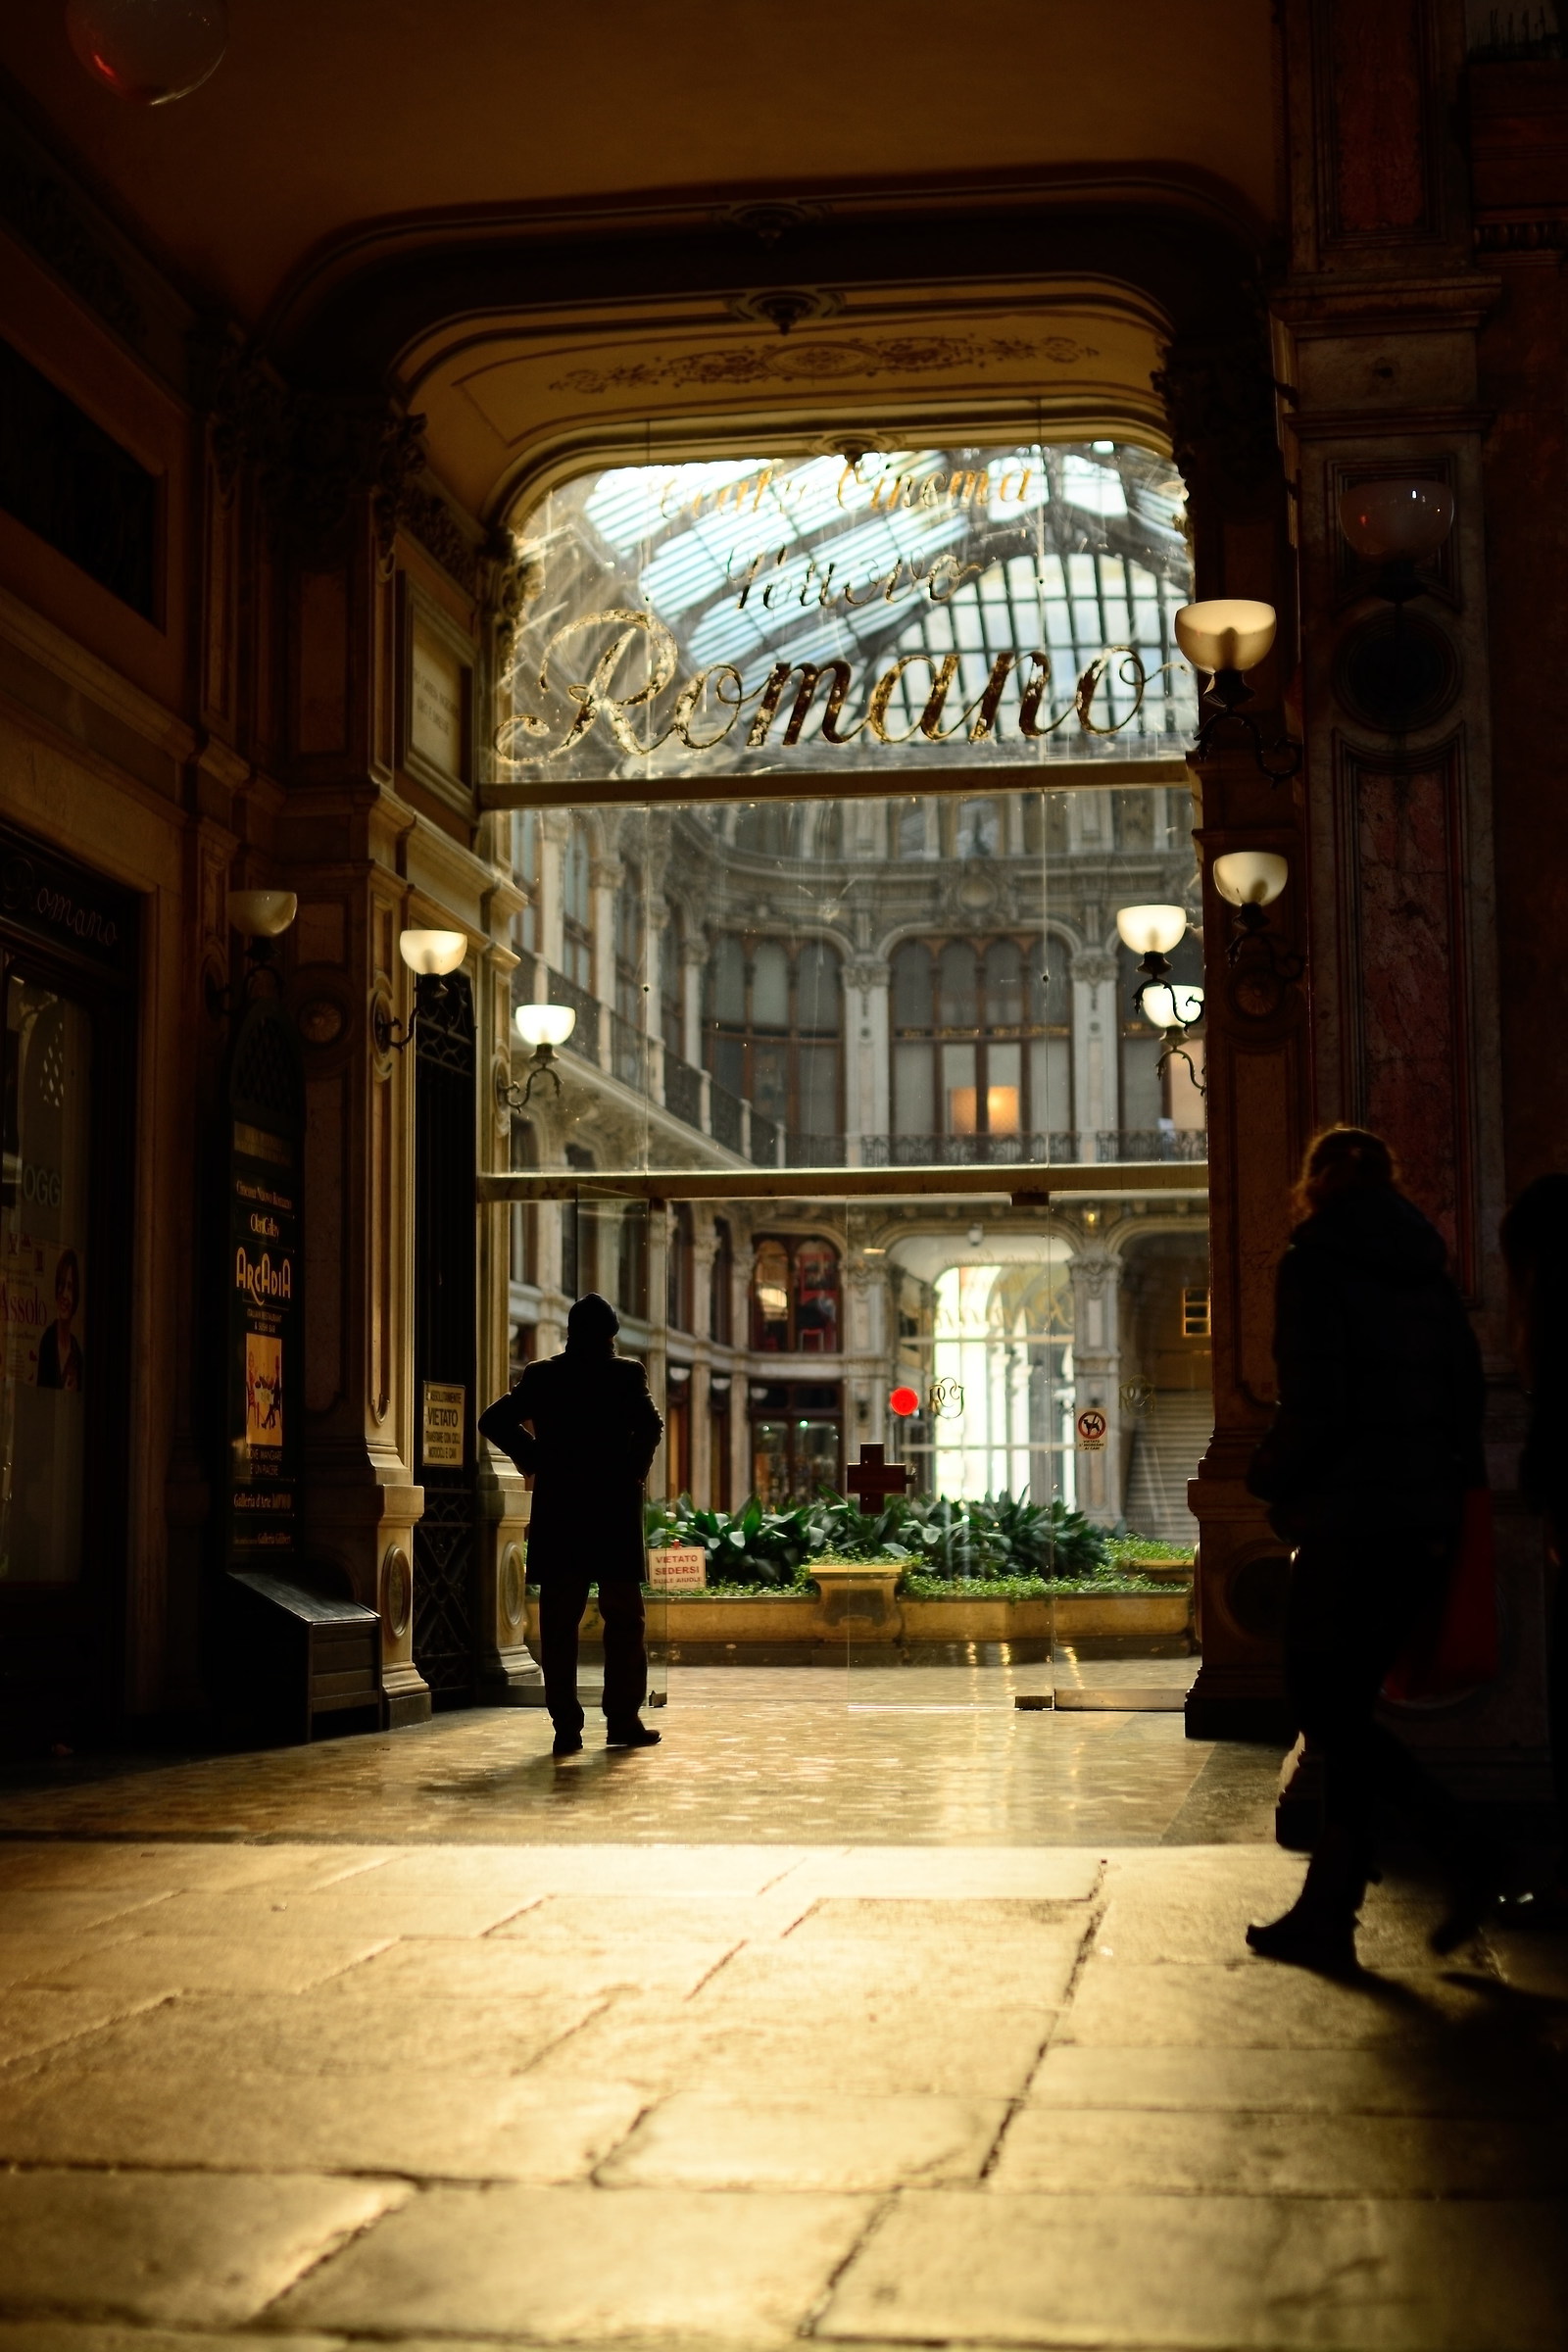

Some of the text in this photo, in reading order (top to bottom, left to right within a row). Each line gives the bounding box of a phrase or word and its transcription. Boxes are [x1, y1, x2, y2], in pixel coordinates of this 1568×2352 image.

[837, 452, 1035, 512] Cinema
[493, 609, 1188, 764] Romano
[1, 856, 119, 948] Romano
[427, 1406, 459, 1428] VIETATO
[655, 1565, 700, 1576] SEDERSI
[656, 1554, 698, 1564] VIETATO
